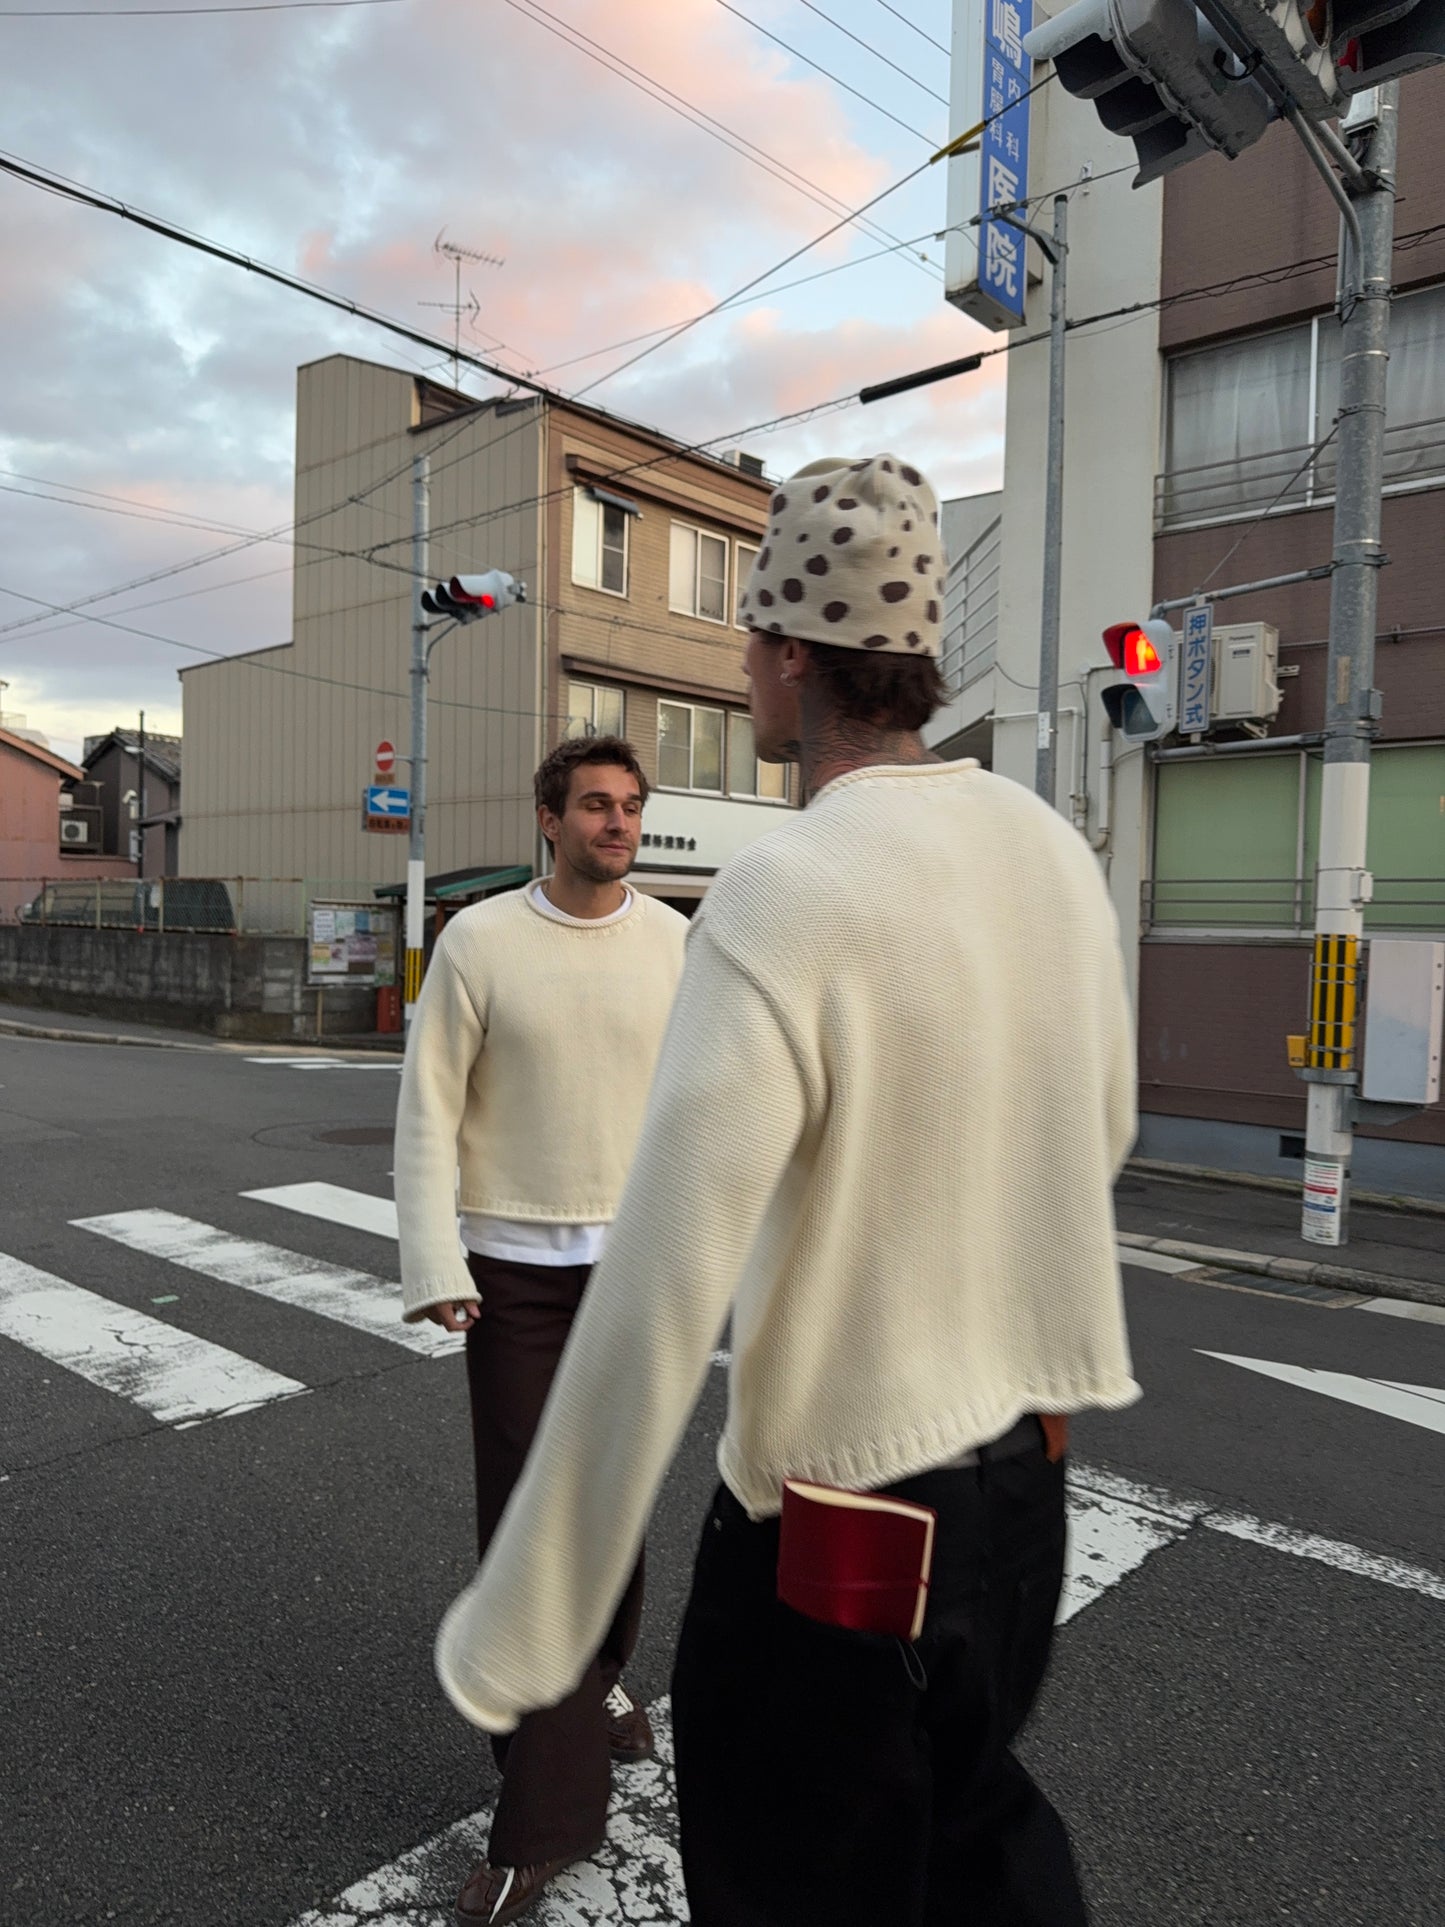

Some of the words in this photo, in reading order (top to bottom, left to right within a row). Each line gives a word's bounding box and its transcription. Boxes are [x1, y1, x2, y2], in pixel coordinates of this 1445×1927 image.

[1006, 77, 1020, 163] 内科
[986, 154, 1019, 298] 医院
[1186, 613, 1206, 724] 押ボタン式
